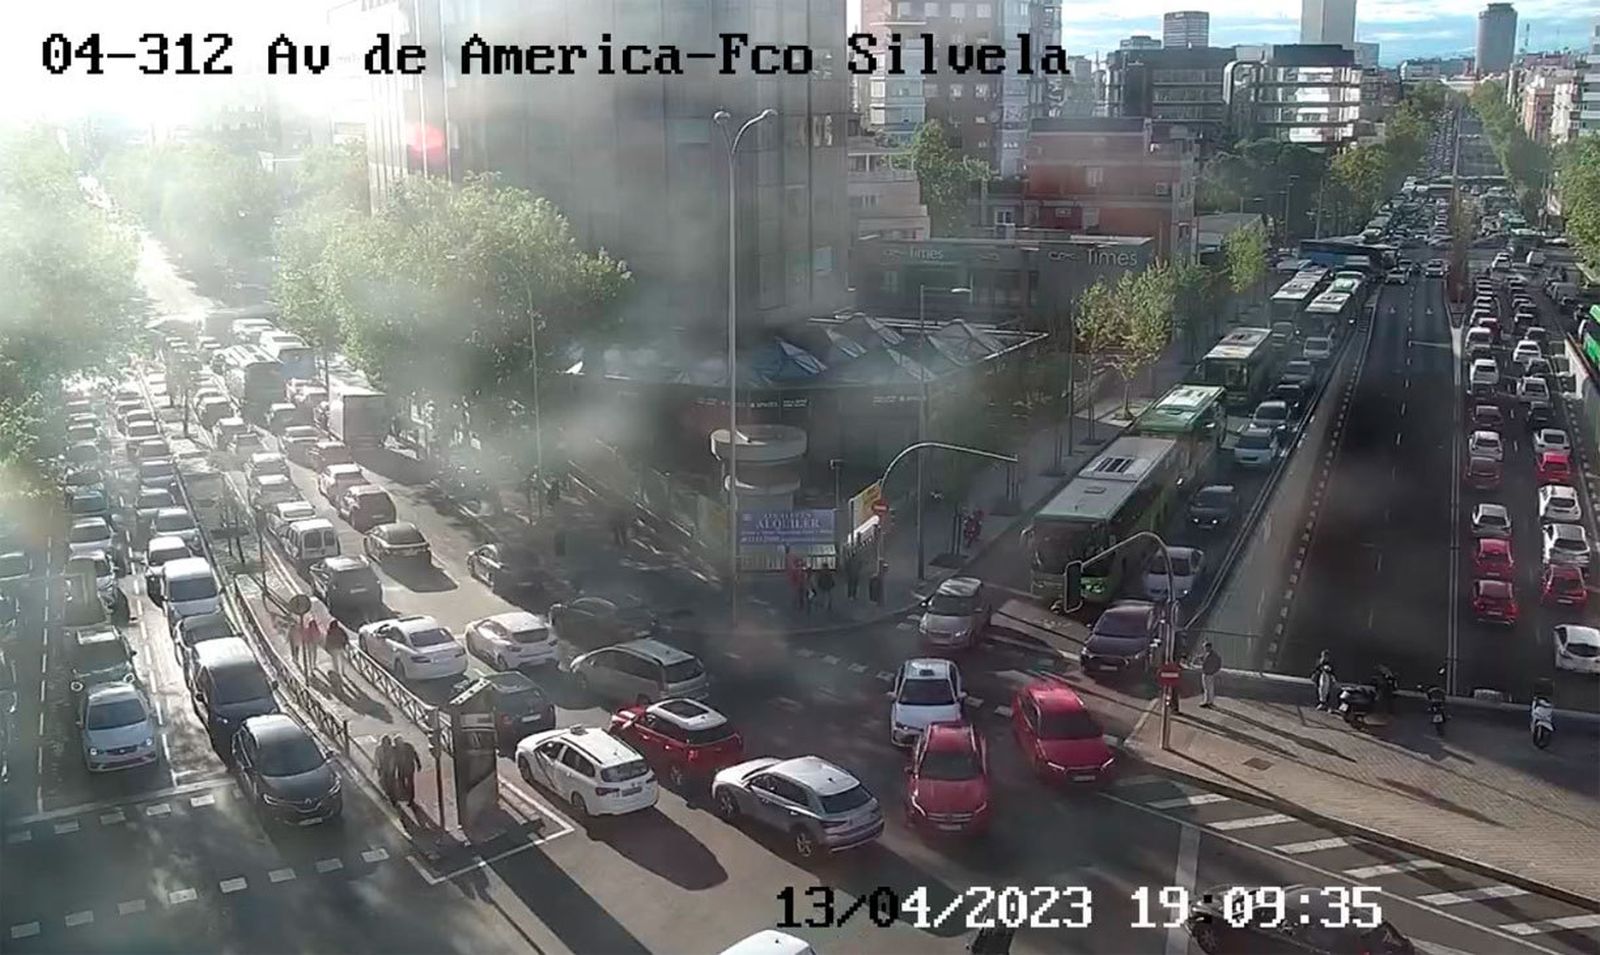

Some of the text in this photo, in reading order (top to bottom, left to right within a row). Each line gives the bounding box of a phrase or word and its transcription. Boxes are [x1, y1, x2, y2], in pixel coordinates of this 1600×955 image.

[909, 245, 944, 260] Times
[1087, 248, 1138, 266] Times
[756, 518, 821, 530] ALQUILER
